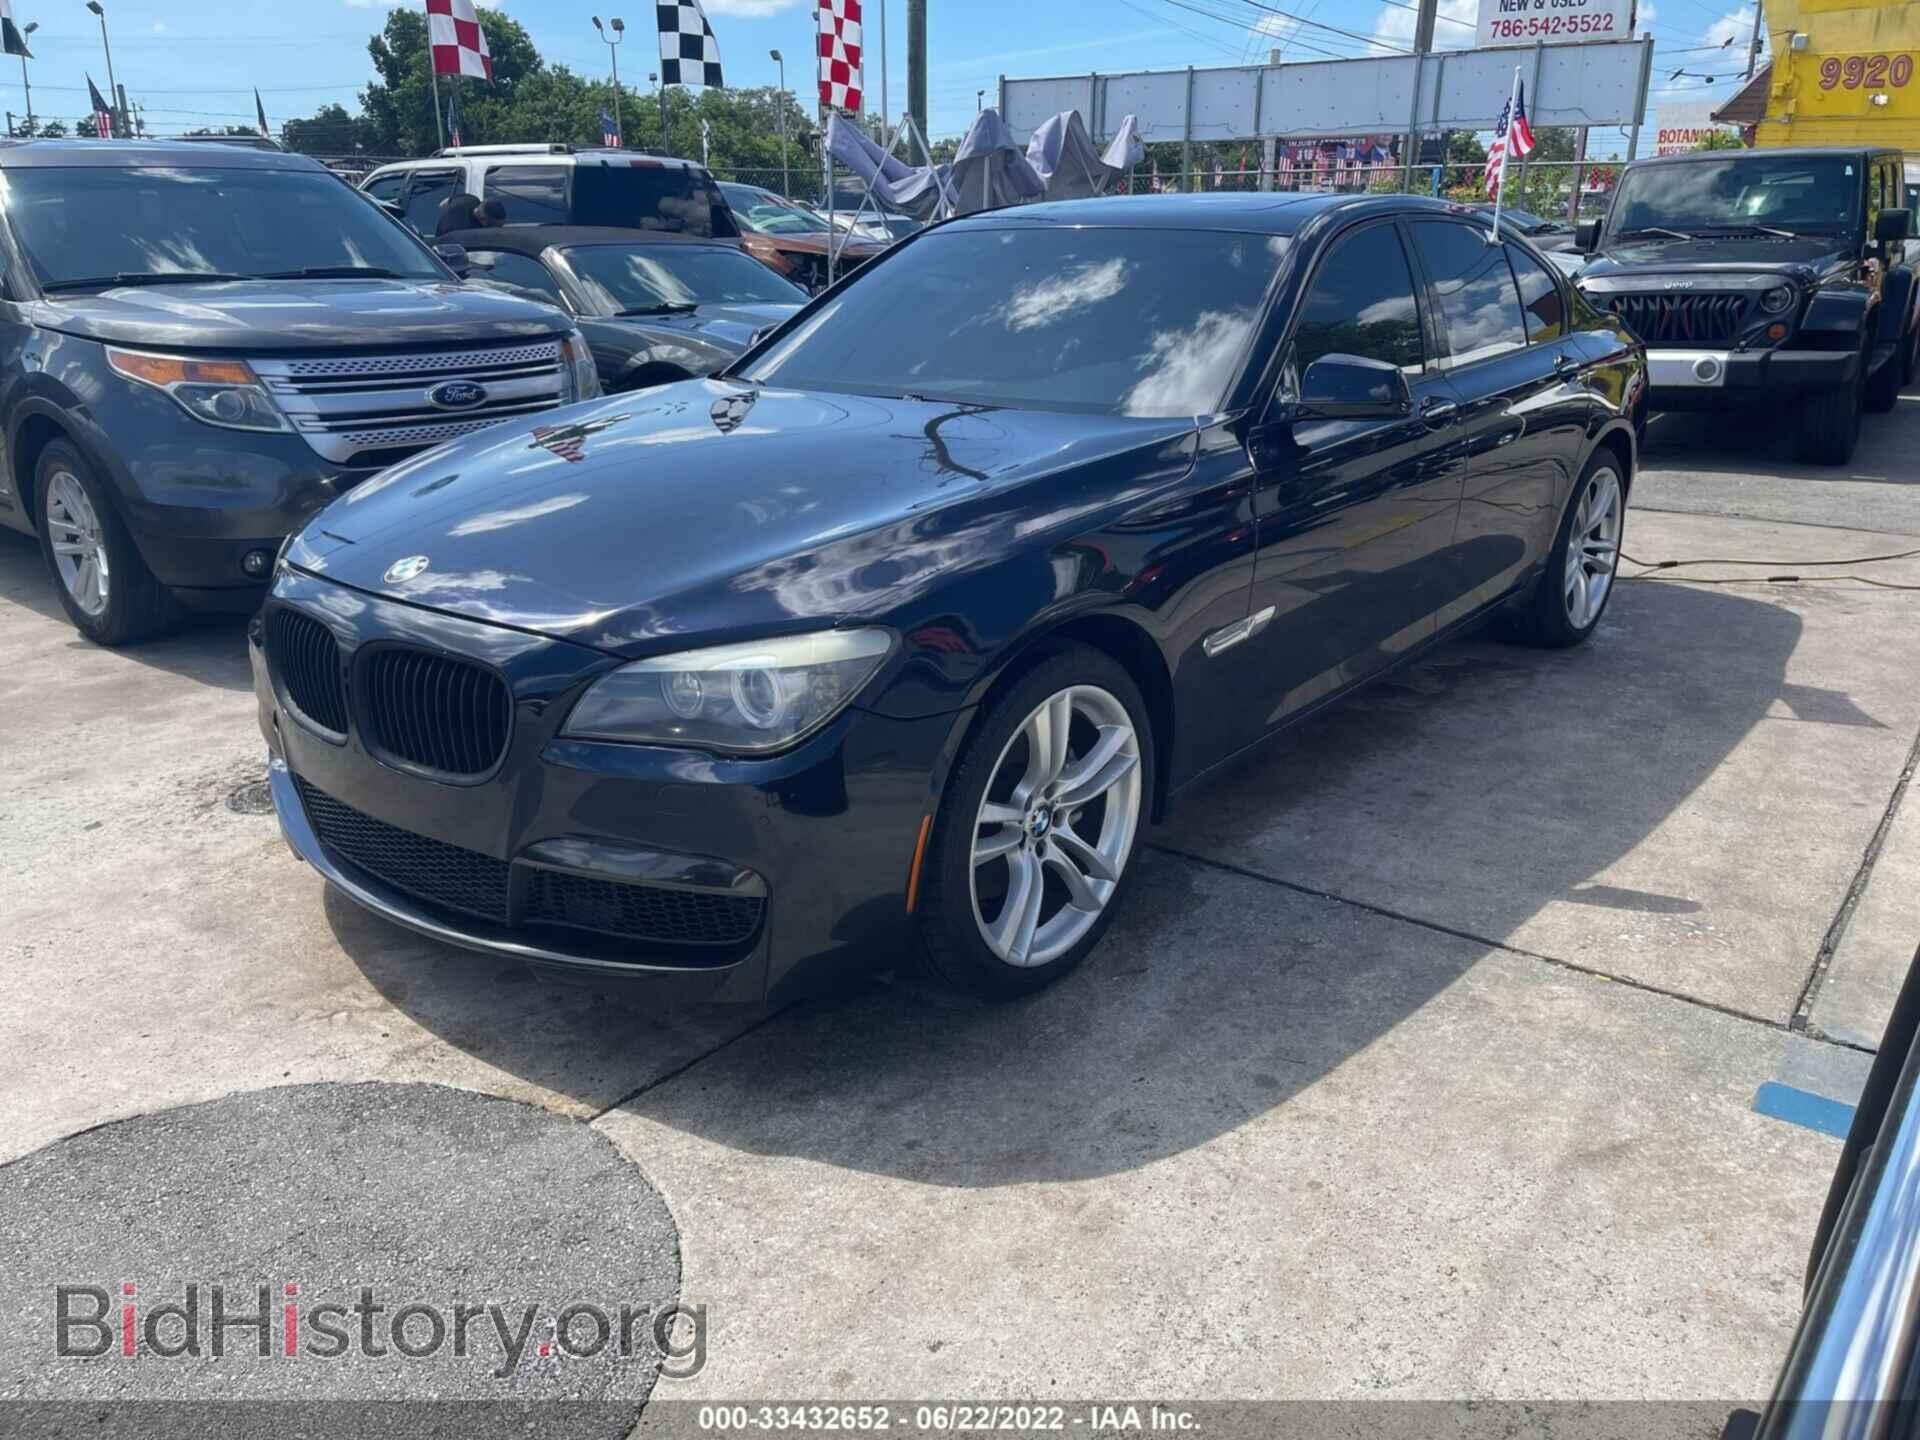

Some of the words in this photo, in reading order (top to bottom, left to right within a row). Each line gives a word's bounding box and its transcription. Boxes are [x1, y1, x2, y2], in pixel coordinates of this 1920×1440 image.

[1499, 0, 1529, 12] NEW
[1818, 54, 1914, 91] 9920
[444, 386, 477, 402] Ford
